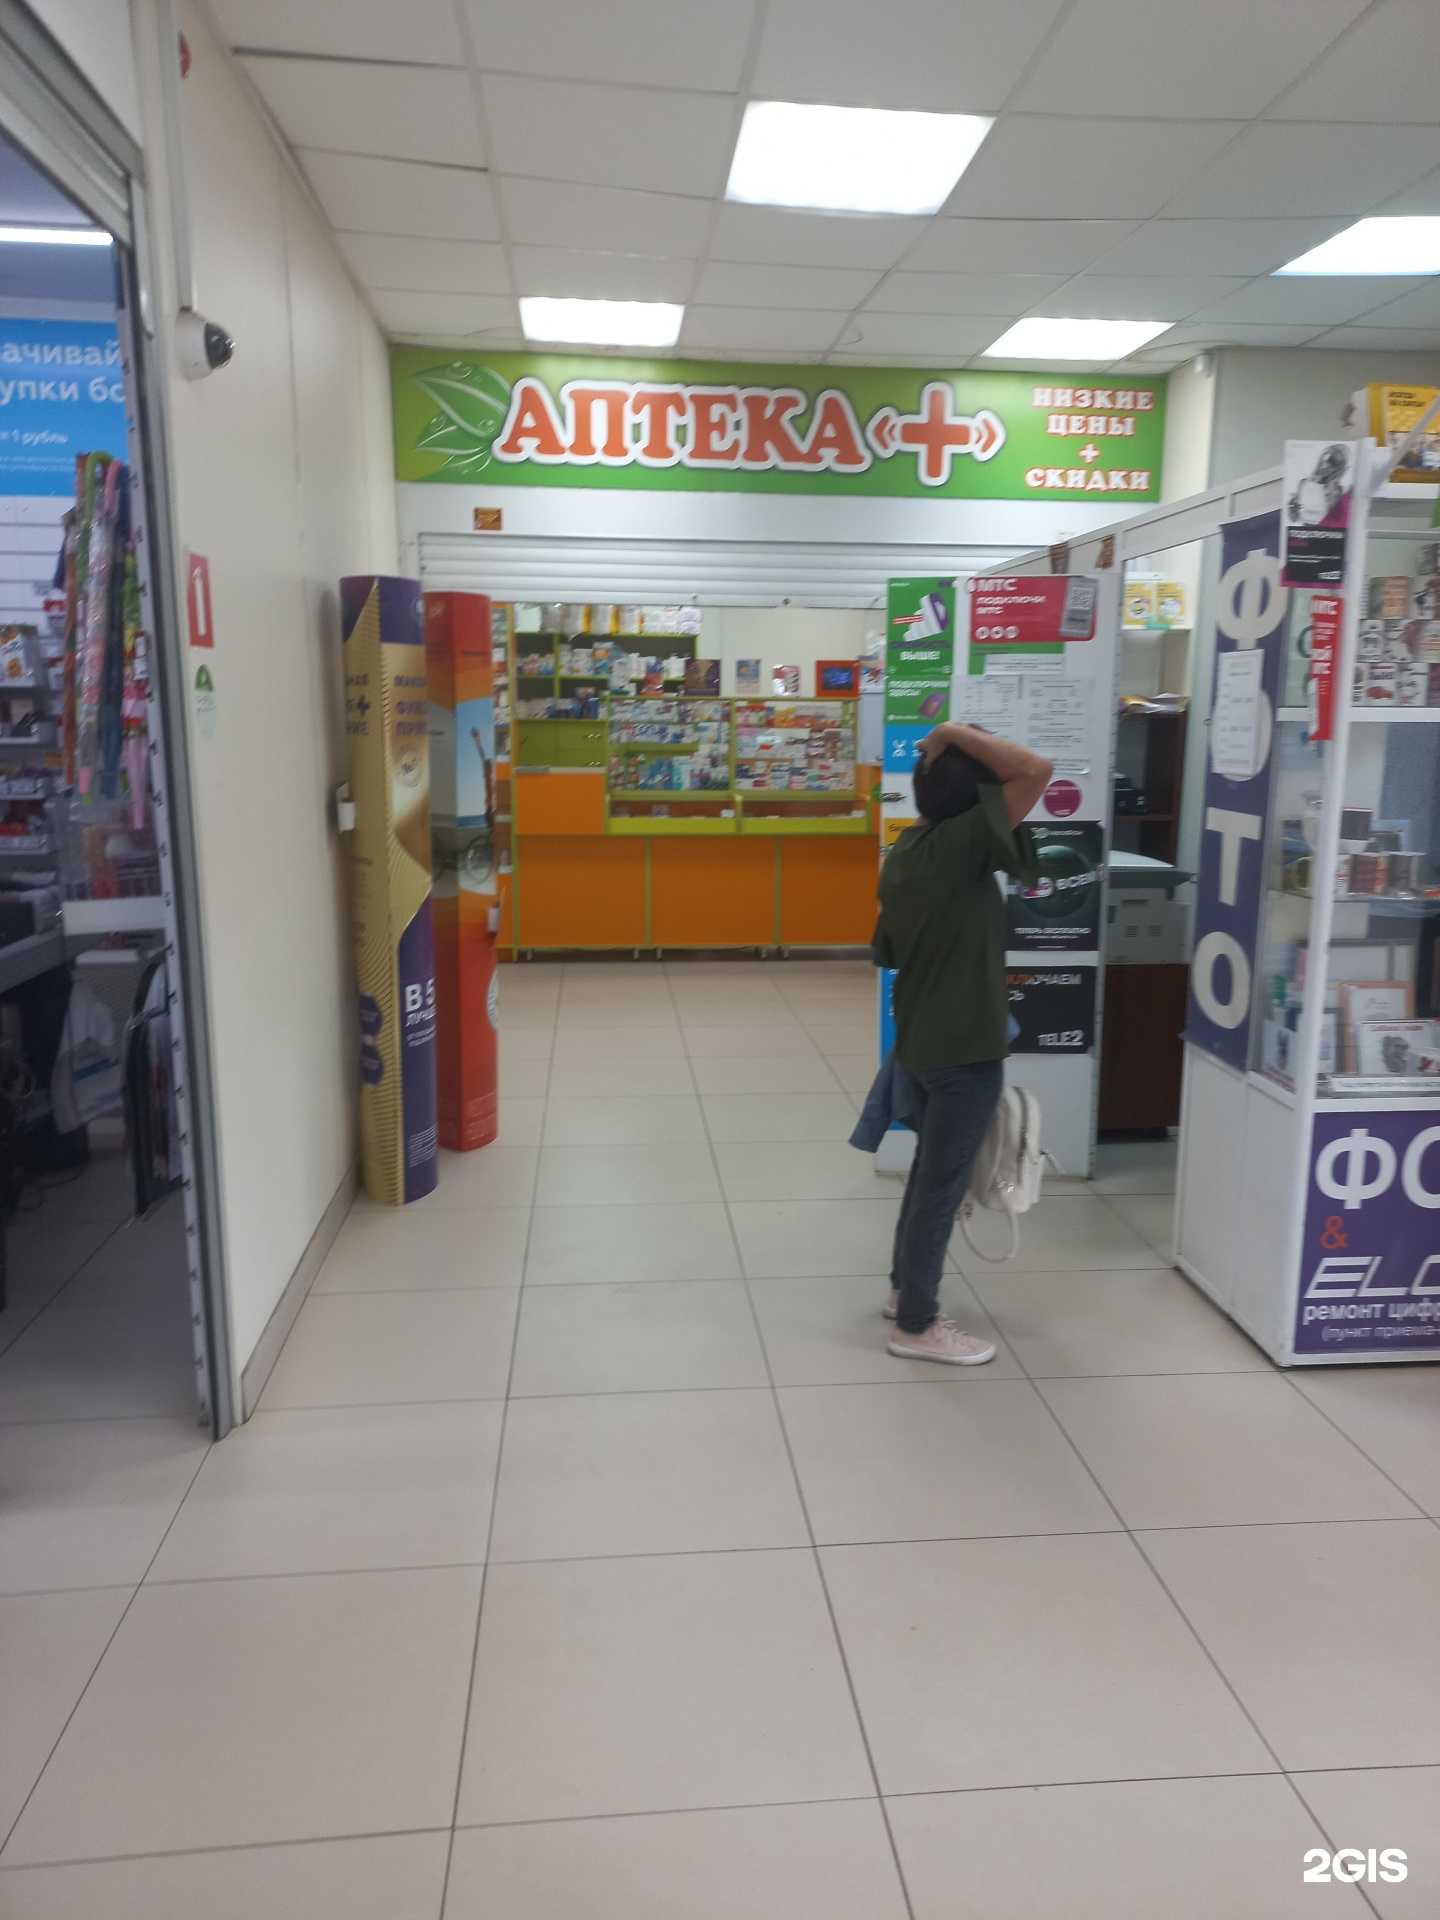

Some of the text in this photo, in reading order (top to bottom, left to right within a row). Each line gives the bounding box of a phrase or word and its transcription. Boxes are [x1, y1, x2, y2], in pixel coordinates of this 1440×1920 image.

[0, 380, 79, 406] упки
[1031, 387, 1153, 411] НИЗКИЕ
[496, 380, 868, 470] АПТЕКА
[1047, 414, 1136, 436] ЦЕНЫ
[1024, 467, 1151, 491] СКИДКИ
[975, 578, 1018, 592] МТС
[1037, 1029, 1084, 1046] TELE2
[1319, 1215, 1349, 1249] &
[1302, 1303, 1385, 1326] ремонт
